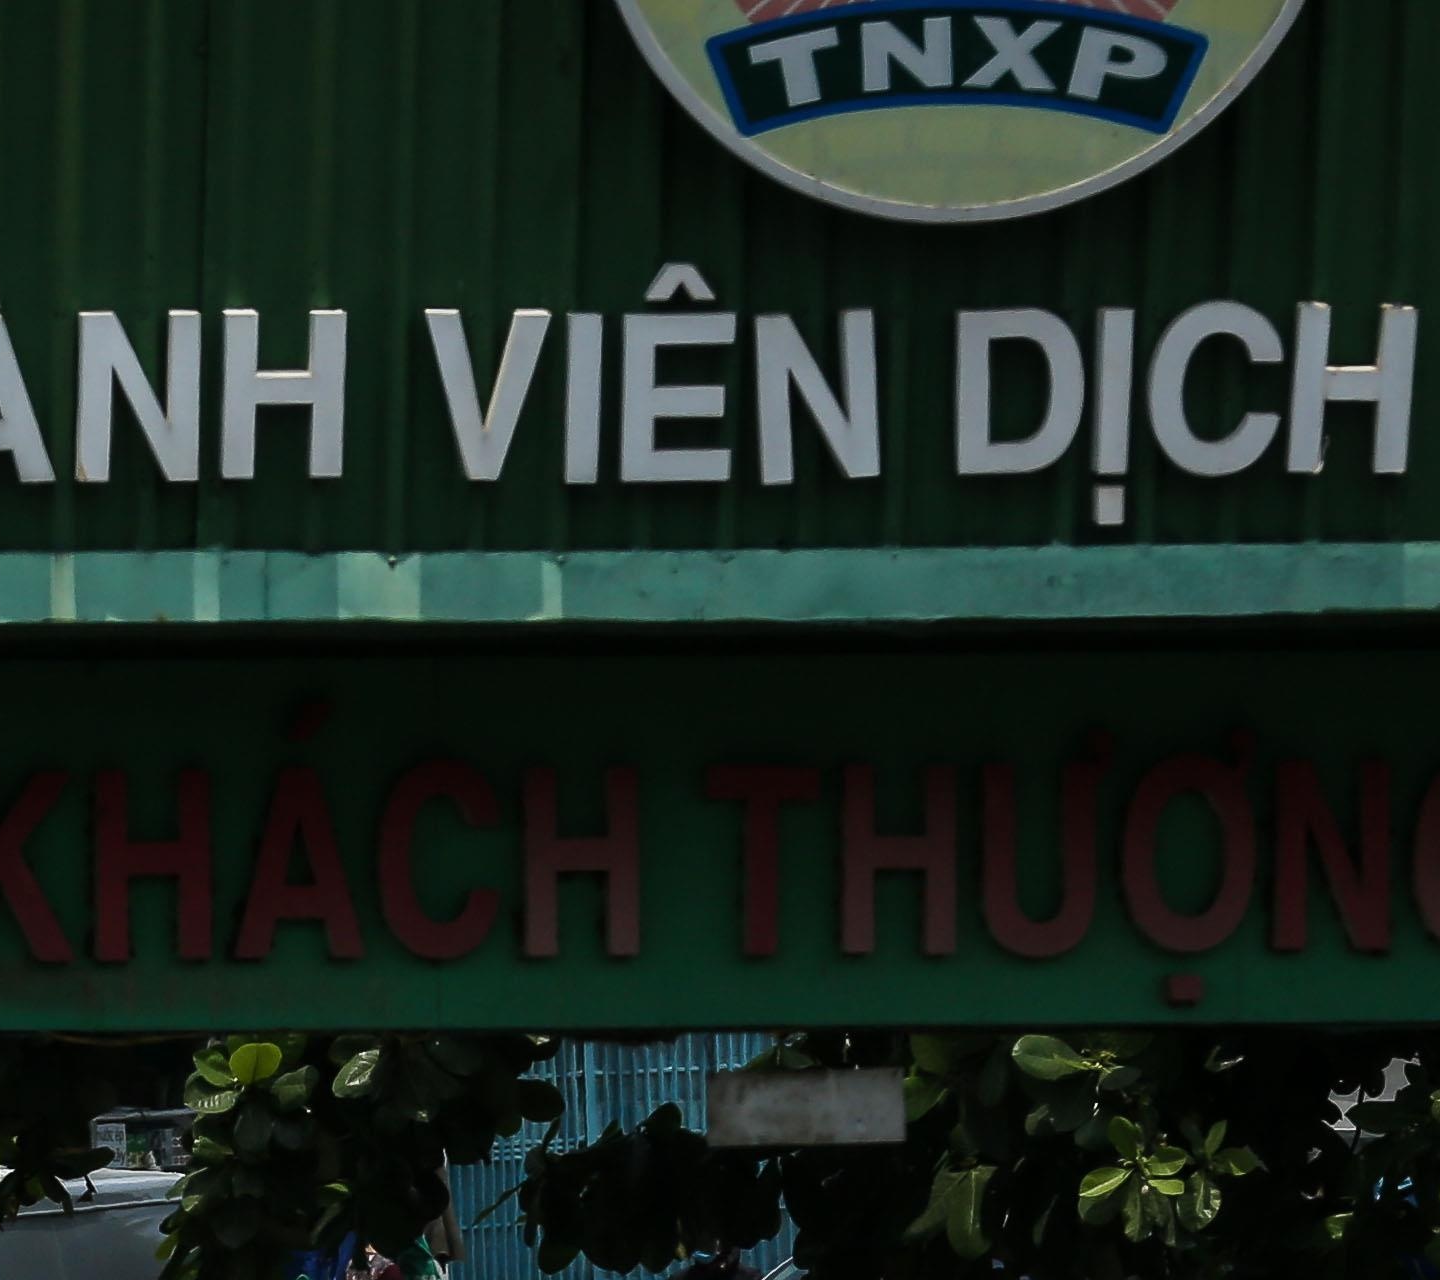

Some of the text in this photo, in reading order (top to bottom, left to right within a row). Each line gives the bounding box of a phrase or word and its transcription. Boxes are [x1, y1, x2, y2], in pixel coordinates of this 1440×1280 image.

[748, 15, 1168, 107] TNXP
[425, 265, 879, 484] VIÊN
[958, 302, 1416, 524] DỊCH
